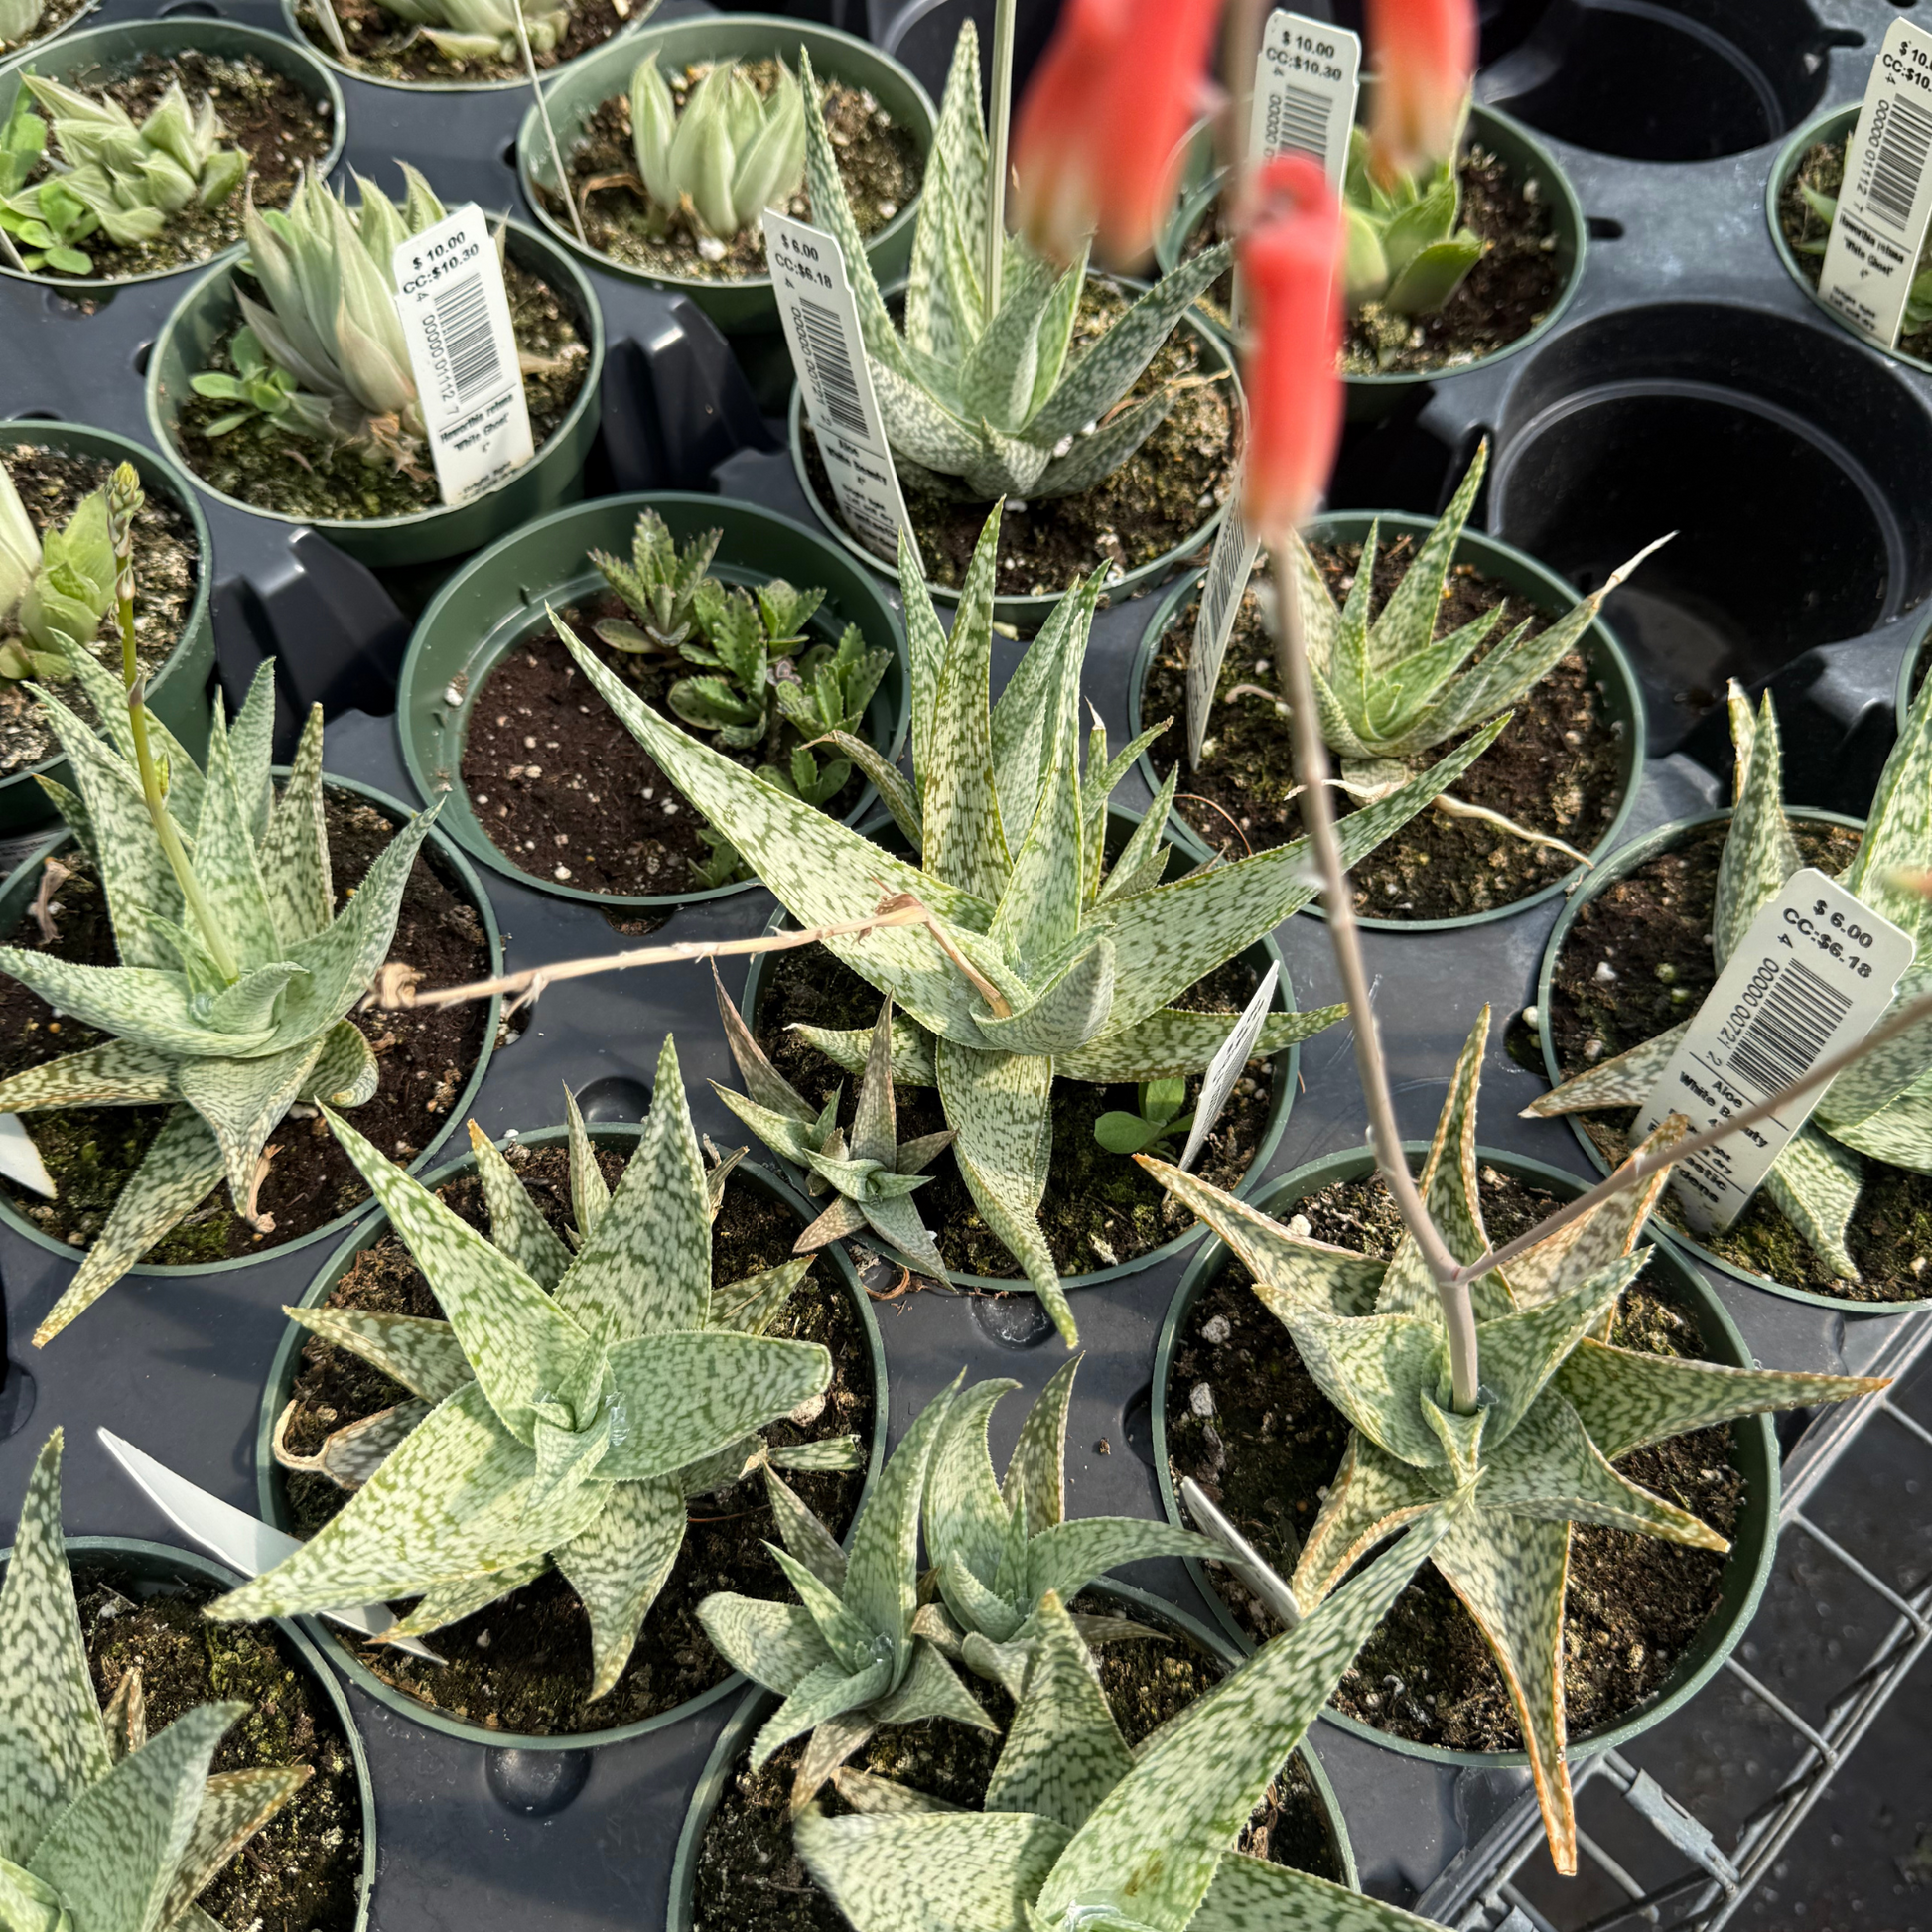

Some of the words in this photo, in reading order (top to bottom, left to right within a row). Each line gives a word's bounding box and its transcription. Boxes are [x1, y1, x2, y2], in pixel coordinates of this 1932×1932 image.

[1266, 47, 1342, 81] CC:$10.30
[1282, 31, 1291, 46] $
[1296, 36, 1335, 58] 10.00
[1899, 41, 1908, 56] $
[1912, 49, 1932, 71] 10.
[1868, 99, 1889, 147] 00000
[1856, 149, 1876, 196] 01112
[403, 243, 480, 294] CC:$10.30
[413, 257, 423, 270] $
[427, 231, 465, 261] 10.00
[775, 252, 833, 289] CC:$6.18
[781, 234, 790, 250] $
[792, 239, 819, 262] 6.00
[791, 306, 812, 356] 00000
[422, 314, 445, 358] 00000
[435, 358, 455, 402] 01112
[446, 406, 460, 416] 7
[1777, 933, 1793, 948] 4
[1783, 907, 1873, 978] CC:$6.18
[1813, 899, 1828, 915] $
[1830, 912, 1873, 948] 6.00
[1741, 957, 1780, 1008] 00000
[1717, 1004, 1751, 1049] 00721
[1705, 1050, 1723, 1067] 2
[1679, 1071, 1716, 1107] White
[1719, 1105, 1768, 1148] Buty
[1712, 1080, 1743, 1108] Aloe
